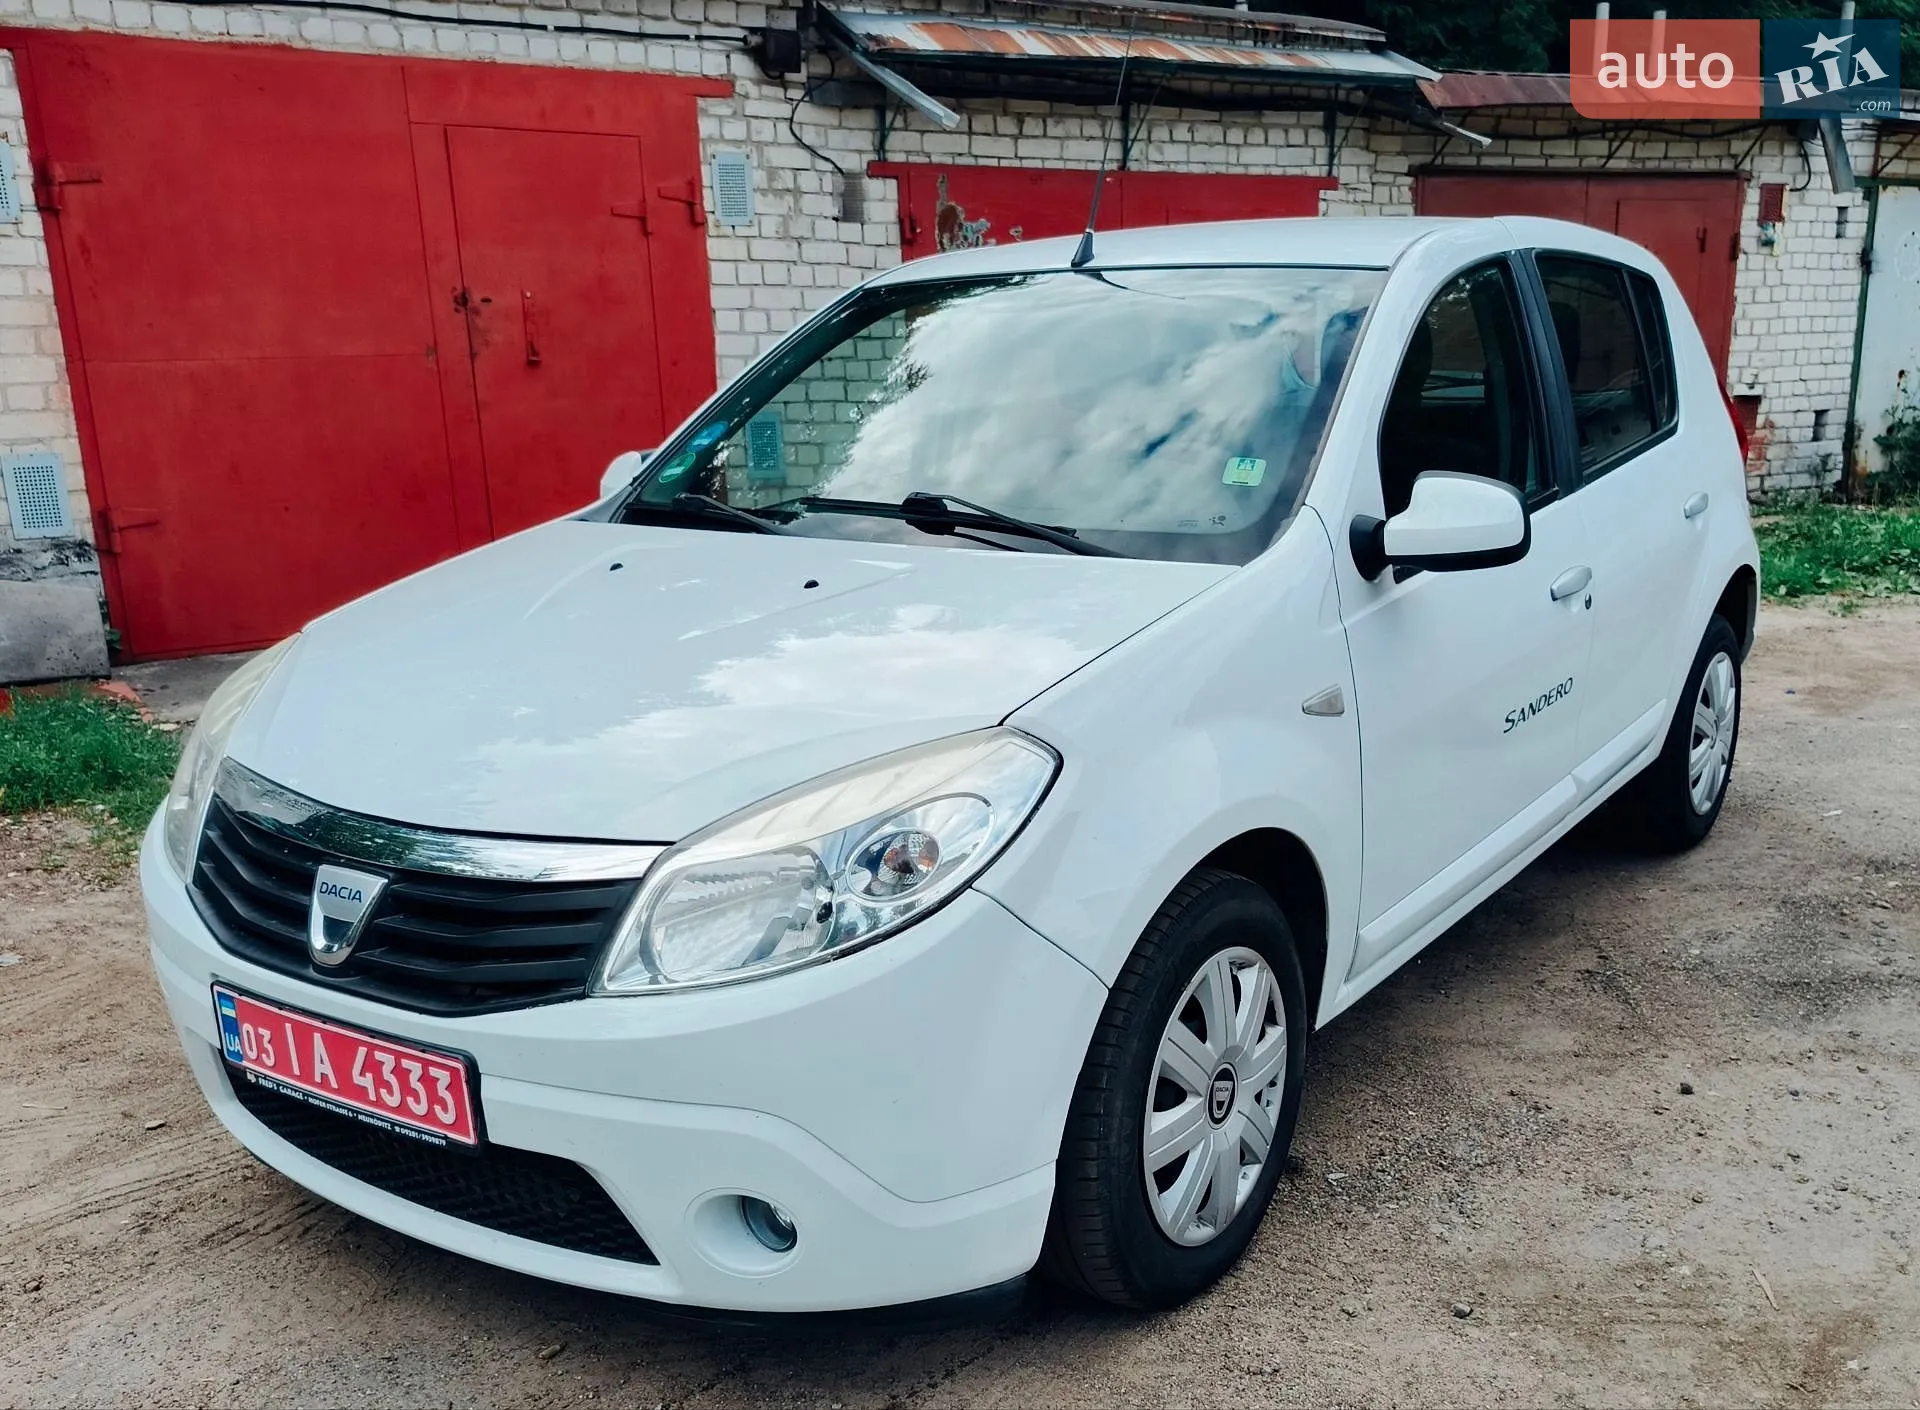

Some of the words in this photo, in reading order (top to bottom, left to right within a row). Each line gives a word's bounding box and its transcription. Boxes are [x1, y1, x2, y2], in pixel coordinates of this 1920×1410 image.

[1503, 677, 1573, 734] SANDERO
[319, 881, 362, 903] DACIA
[225, 1033, 242, 1055] UA
[242, 1023, 276, 1067] 03
[351, 1046, 457, 1126] 4333
[279, 1085, 304, 1101] GARAGE
